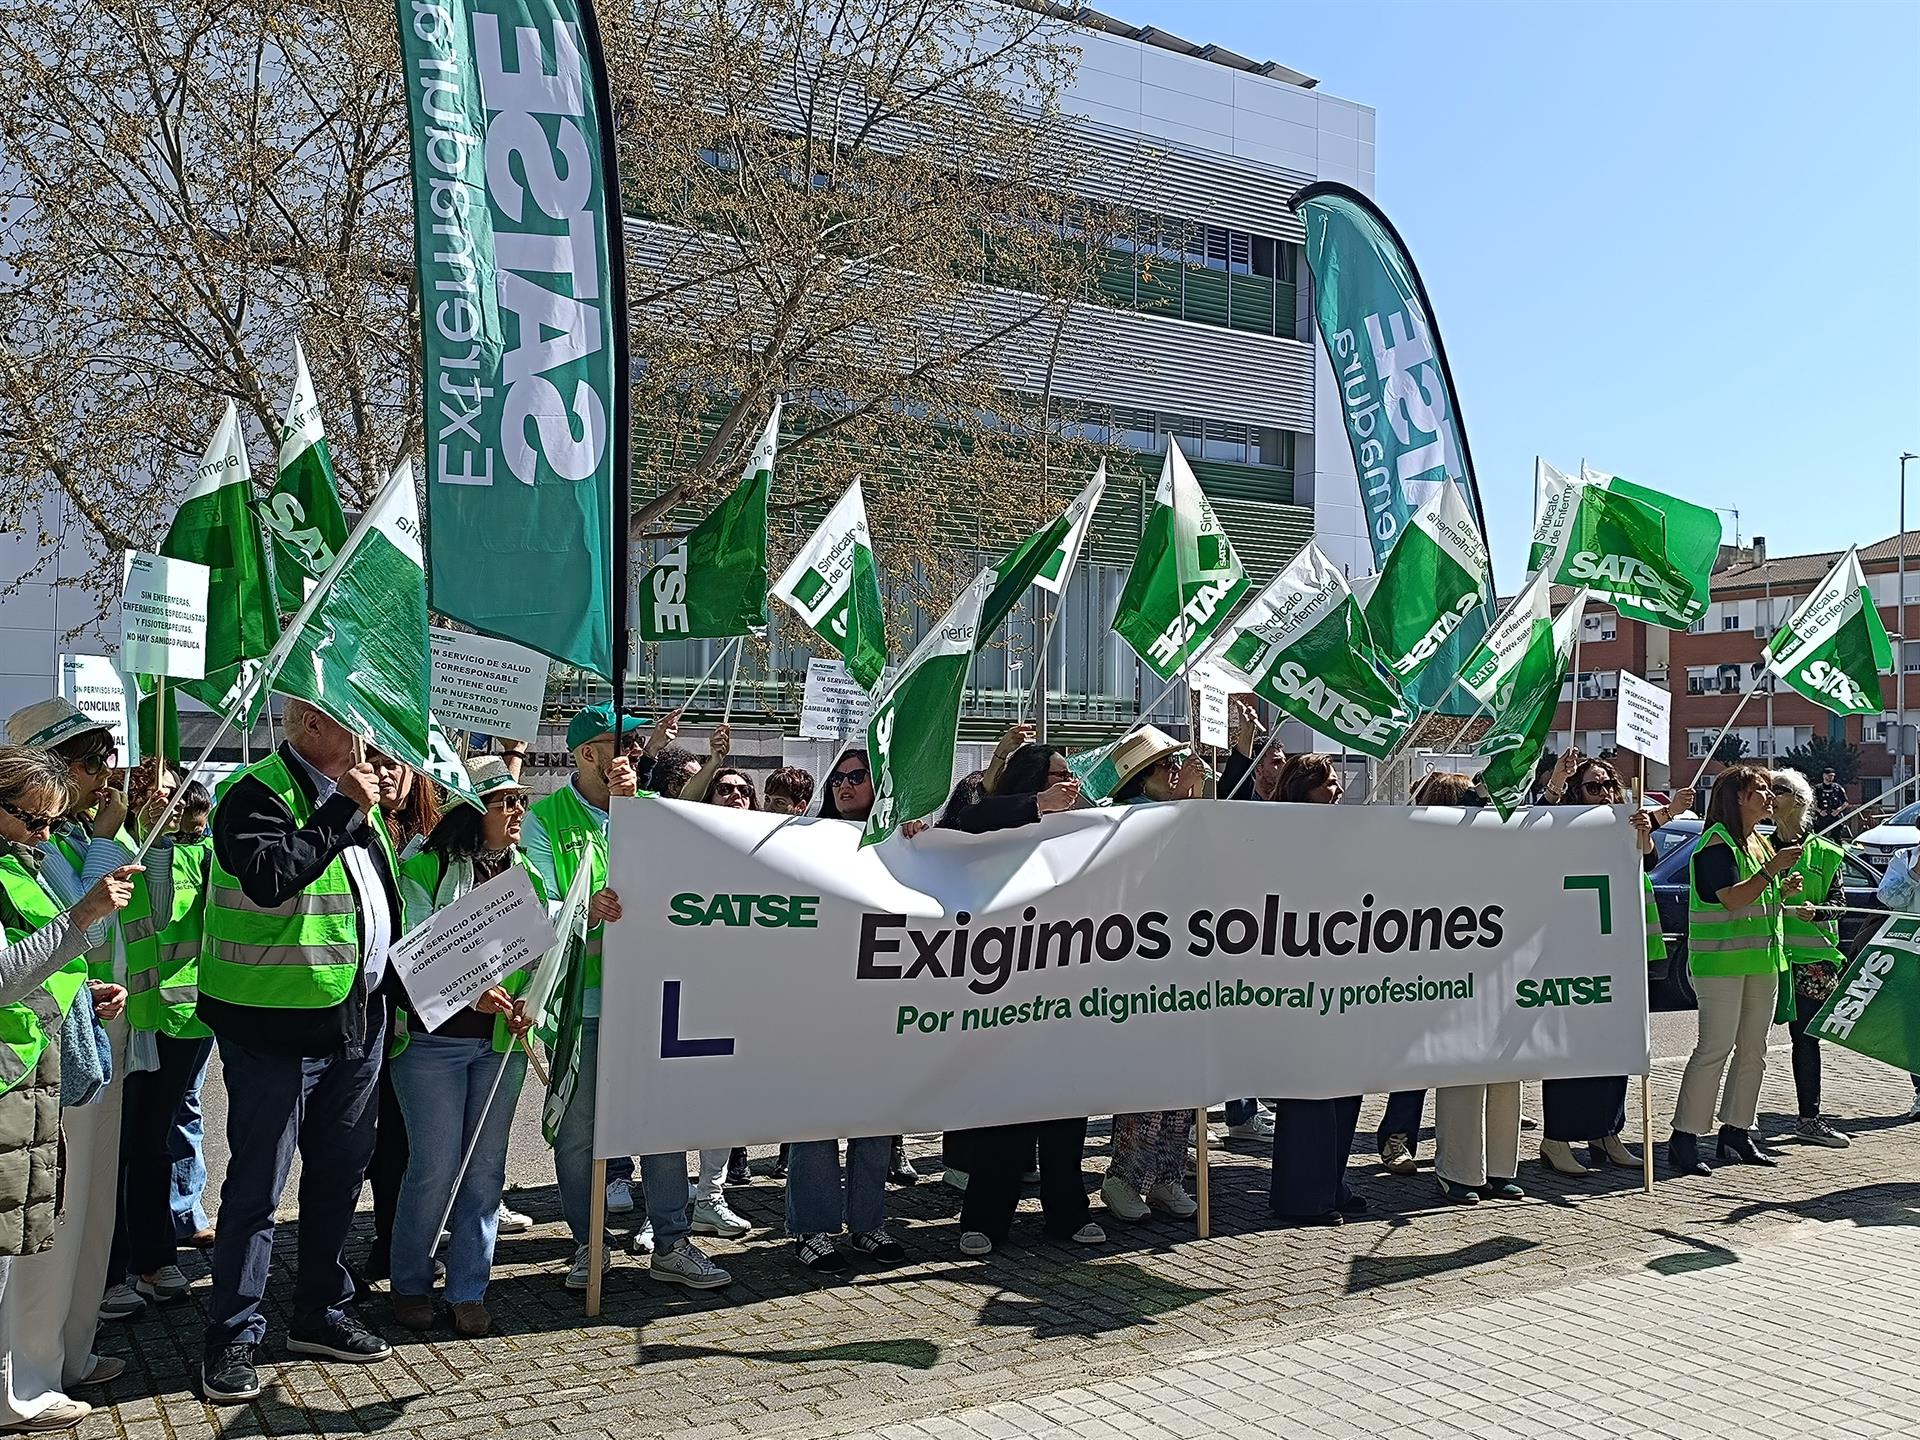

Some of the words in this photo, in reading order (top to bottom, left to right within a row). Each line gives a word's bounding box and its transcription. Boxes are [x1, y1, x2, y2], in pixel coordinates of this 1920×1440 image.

[1534, 493, 1560, 541] Sindicato
[1568, 551, 1686, 609] SATSE
[122, 601, 164, 616] ENFERMEROS
[140, 590, 152, 600] SIN
[135, 617, 141, 626] Y
[1254, 591, 1303, 635] Sindicato
[1792, 589, 1840, 630] Sindicato
[127, 631, 136, 641] NO
[137, 633, 150, 643] HAY
[150, 635, 176, 646] SANIDAD
[1268, 632, 1285, 644] de
[1803, 625, 1819, 639] de
[430, 648, 440, 656] N
[441, 649, 485, 665] SERVICIO
[486, 659, 499, 668] DE
[500, 662, 531, 674] SALUD
[1244, 643, 1268, 673] SATSE
[1469, 654, 1500, 687] SATSE
[434, 661, 519, 684] CORRESPONSABLE
[441, 675, 455, 684] NO
[456, 678, 484, 690] TIENE
[827, 676, 855, 685] SERVICIO
[73, 685, 83, 694] SIN
[430, 685, 448, 696] IAR
[449, 688, 498, 705] NUESTROS
[501, 699, 539, 713] TURNOS
[836, 698, 855, 706] TIENE
[78, 700, 121, 712] CONCILIAR
[442, 699, 455, 707] DE
[457, 701, 499, 716] TRABAJO
[804, 705, 831, 713] CAMBIAR
[831, 706, 864, 716] NUESTROS
[1272, 661, 1396, 747] SATSE
[667, 892, 820, 928] SATSE
[410, 948, 426, 961] UN
[425, 918, 470, 950] SERVICIO
[470, 909, 483, 921] DE
[484, 889, 515, 912] SALUD
[411, 916, 496, 975] CORRESPONSABLE
[495, 897, 524, 918] TIENE
[461, 936, 485, 954] QUE:
[855, 904, 1172, 996] Exigimos
[1186, 893, 1504, 959] soluciones
[439, 961, 489, 998] SUSTITUIR
[489, 952, 501, 965] EL
[502, 936, 526, 955] 100%
[446, 993, 460, 1007] DE
[460, 982, 479, 997] LAS
[480, 947, 530, 985] AUSENCIAS
[896, 1004, 956, 1035] Por
[961, 993, 1071, 1032] nuestra
[1079, 981, 1210, 1024] dignidad
[1214, 978, 1314, 1010] laboral
[1319, 985, 1335, 1017] y
[1338, 972, 1475, 1014] profesional
[1515, 975, 1612, 1009] SATSE
[1820, 950, 1895, 1041] SATSE
